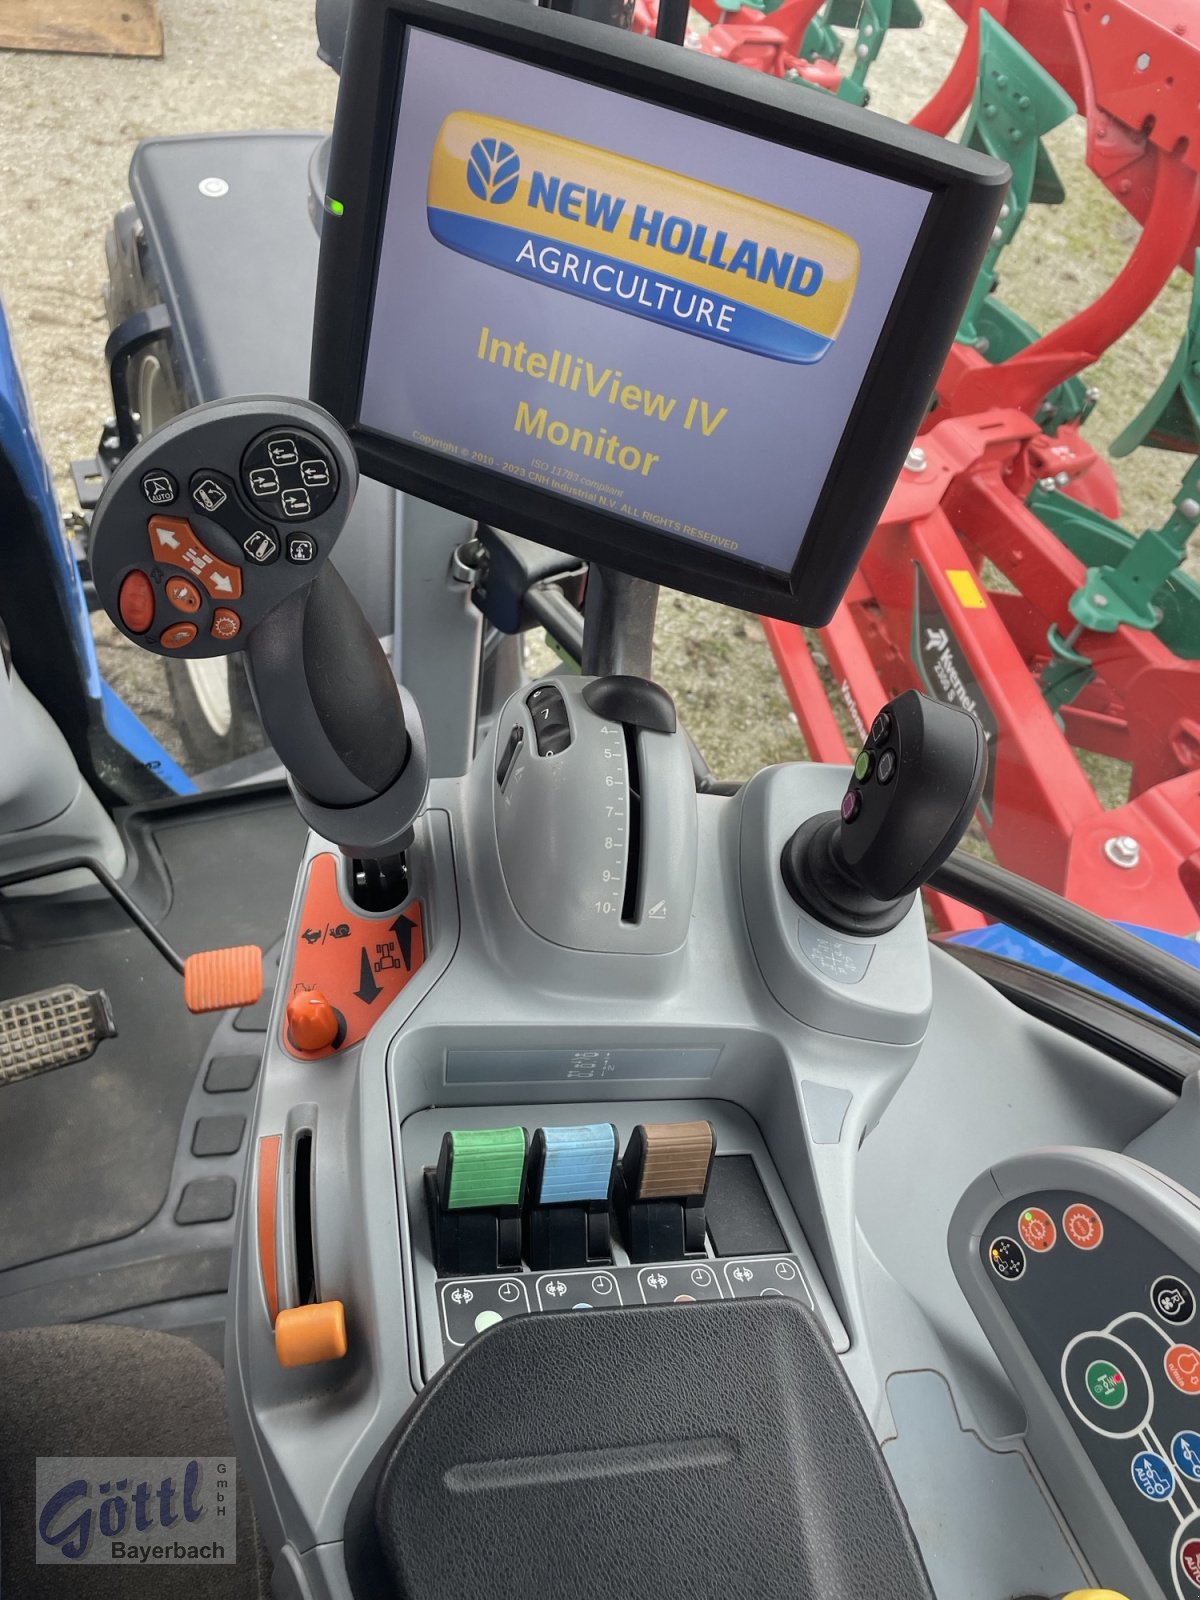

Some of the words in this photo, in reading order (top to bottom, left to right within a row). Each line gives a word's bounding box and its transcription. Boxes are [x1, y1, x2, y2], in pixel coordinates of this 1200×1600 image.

[528, 170, 626, 234] NEW
[630, 204, 824, 298] HOLLAND
[515, 239, 737, 334] AGRICULTURE
[476, 326, 677, 422] IntelliView
[683, 397, 728, 438] IV
[513, 400, 660, 477] Monitor
[531, 457, 549, 471] ISO
[551, 465, 580, 482] 11783
[580, 476, 625, 498] compliant
[412, 430, 458, 454] Copyright
[471, 451, 494, 466] 2010
[502, 462, 526, 477] 2023
[528, 471, 550, 486] CNH
[551, 476, 597, 502] Industrial
[598, 495, 618, 510] N.V.
[620, 503, 639, 517] ALL
[642, 511, 681, 531] RIGHTS
[683, 524, 739, 551] RESERVED
[153, 492, 171, 501] AUTO
[541, 708, 549, 719] 7
[600, 726, 609, 734] 4
[604, 749, 612, 759] 5
[605, 776, 613, 786] 6
[605, 807, 614, 817] 7
[604, 837, 613, 848] 8
[602, 870, 611, 882] 9
[1171, 1294, 1180, 1303] R
[1135, 1467, 1155, 1495] AUTO
